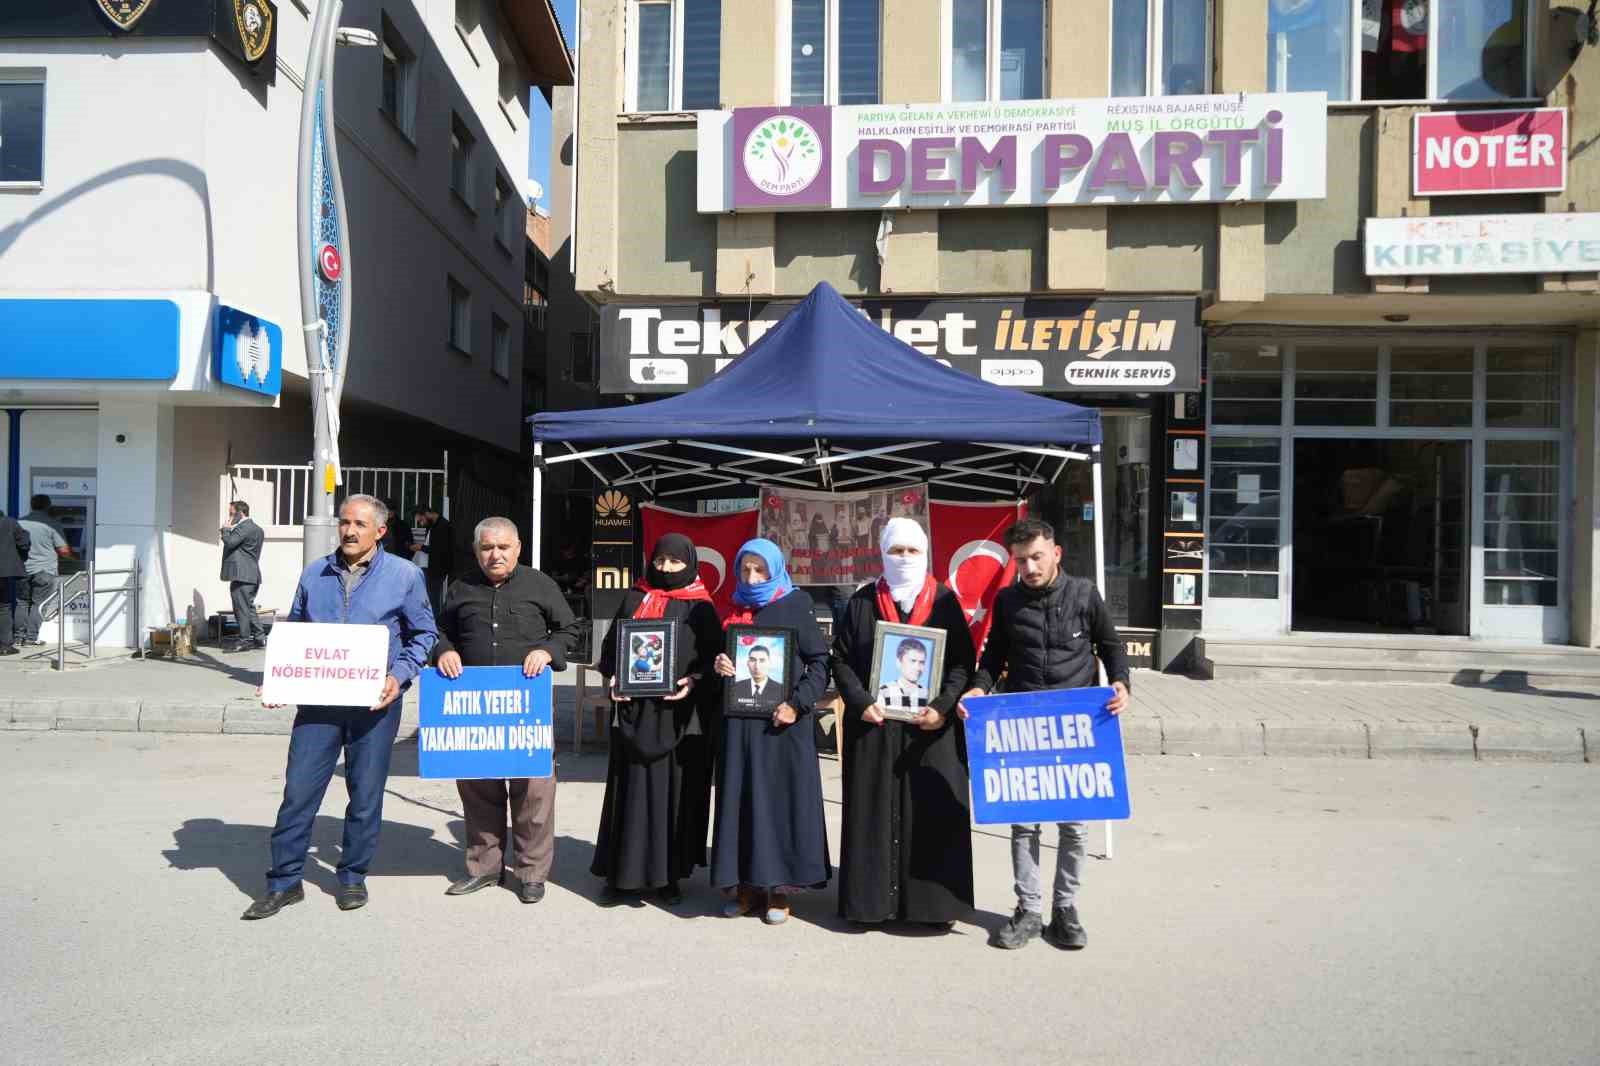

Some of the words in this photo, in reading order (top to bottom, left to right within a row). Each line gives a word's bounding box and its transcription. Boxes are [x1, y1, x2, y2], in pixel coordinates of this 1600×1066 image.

[899, 111, 934, 121] GELAN
[1107, 118, 1144, 134] MUŞ
[858, 126, 916, 137] HALKLARIN
[959, 124, 972, 134] VE
[974, 121, 1032, 134] DEMOKRASİ
[1036, 119, 1077, 132] PARTİSİ
[858, 135, 1018, 195] DEM
[1043, 110, 1284, 192] PARTİ
[1424, 133, 1556, 169] NOTER
[994, 309, 1177, 360] İLETİŞİM
[1069, 365, 1119, 379] TEKNİK
[1124, 365, 1172, 379] SERVİS
[595, 519, 632, 527] HUAWEI
[304, 647, 350, 661] EVLAT
[271, 664, 380, 681] NÖBETİNDEYİZ
[443, 690, 482, 716] ARTIK
[484, 689, 522, 715] YETER
[420, 726, 505, 752] YAKAMIZDAN
[508, 718, 552, 758] DÜŞÜN
[985, 713, 1096, 754] ANNELER
[983, 755, 1115, 803] DİRENİYOR
